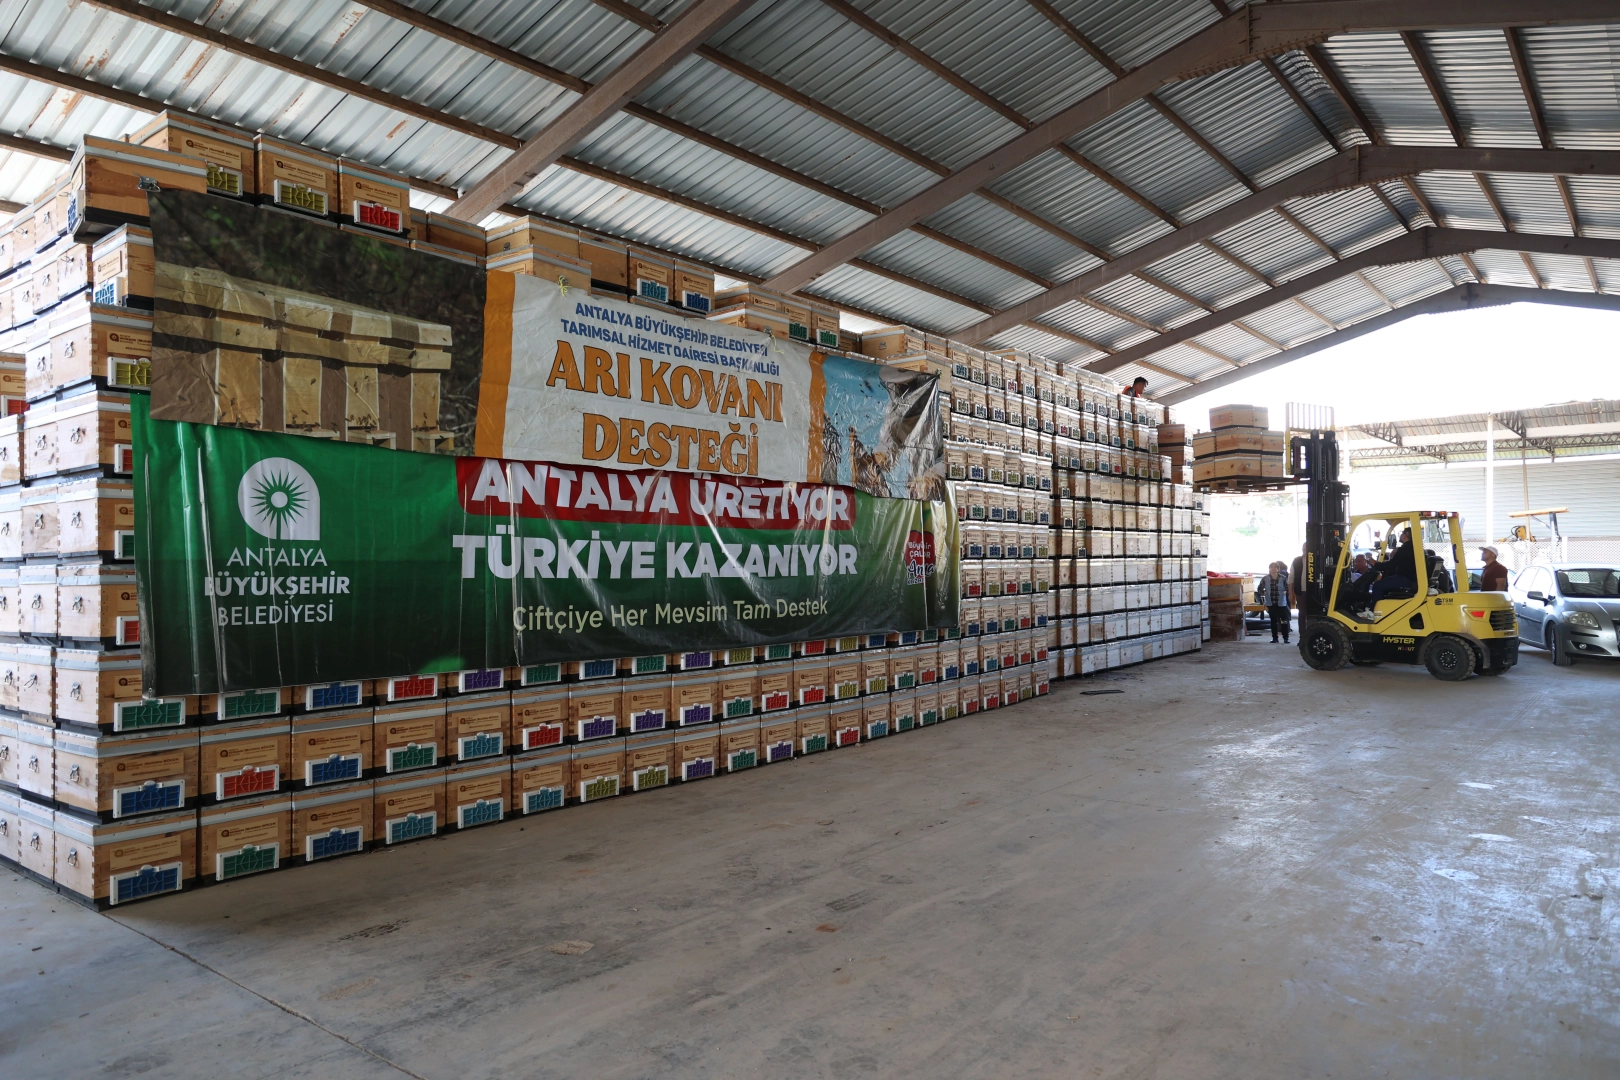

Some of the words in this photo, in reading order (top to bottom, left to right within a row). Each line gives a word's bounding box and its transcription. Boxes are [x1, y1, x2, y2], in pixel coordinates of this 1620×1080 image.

[575, 302, 633, 327] ANTALYA
[635, 314, 708, 345] BÜYÜKŞEHİR
[561, 318, 626, 346] TARIMSAL
[628, 335, 672, 355] HİZMET
[674, 347, 719, 365] DAİRESİ
[721, 356, 780, 377] BAŞKANLIĞI
[546, 340, 632, 399] ARI
[639, 356, 784, 423] KOVANI
[582, 412, 759, 477] DESTEĞİ
[471, 458, 679, 515] ANTALYA
[226, 547, 328, 567] ANTALYA
[452, 524, 656, 580] TÜRKİYE
[665, 541, 858, 579] KAZANIYOR
[204, 570, 351, 599] BÜYÜKŞEHİR
[217, 598, 334, 627] BELEDİYESİ
[512, 605, 604, 635] Çiftçiye
[610, 604, 650, 627] Her
[654, 601, 728, 624] Mevsim
[733, 599, 771, 620] Tam
[776, 596, 829, 616] Destek
[1382, 636, 1415, 645] HYSTER
